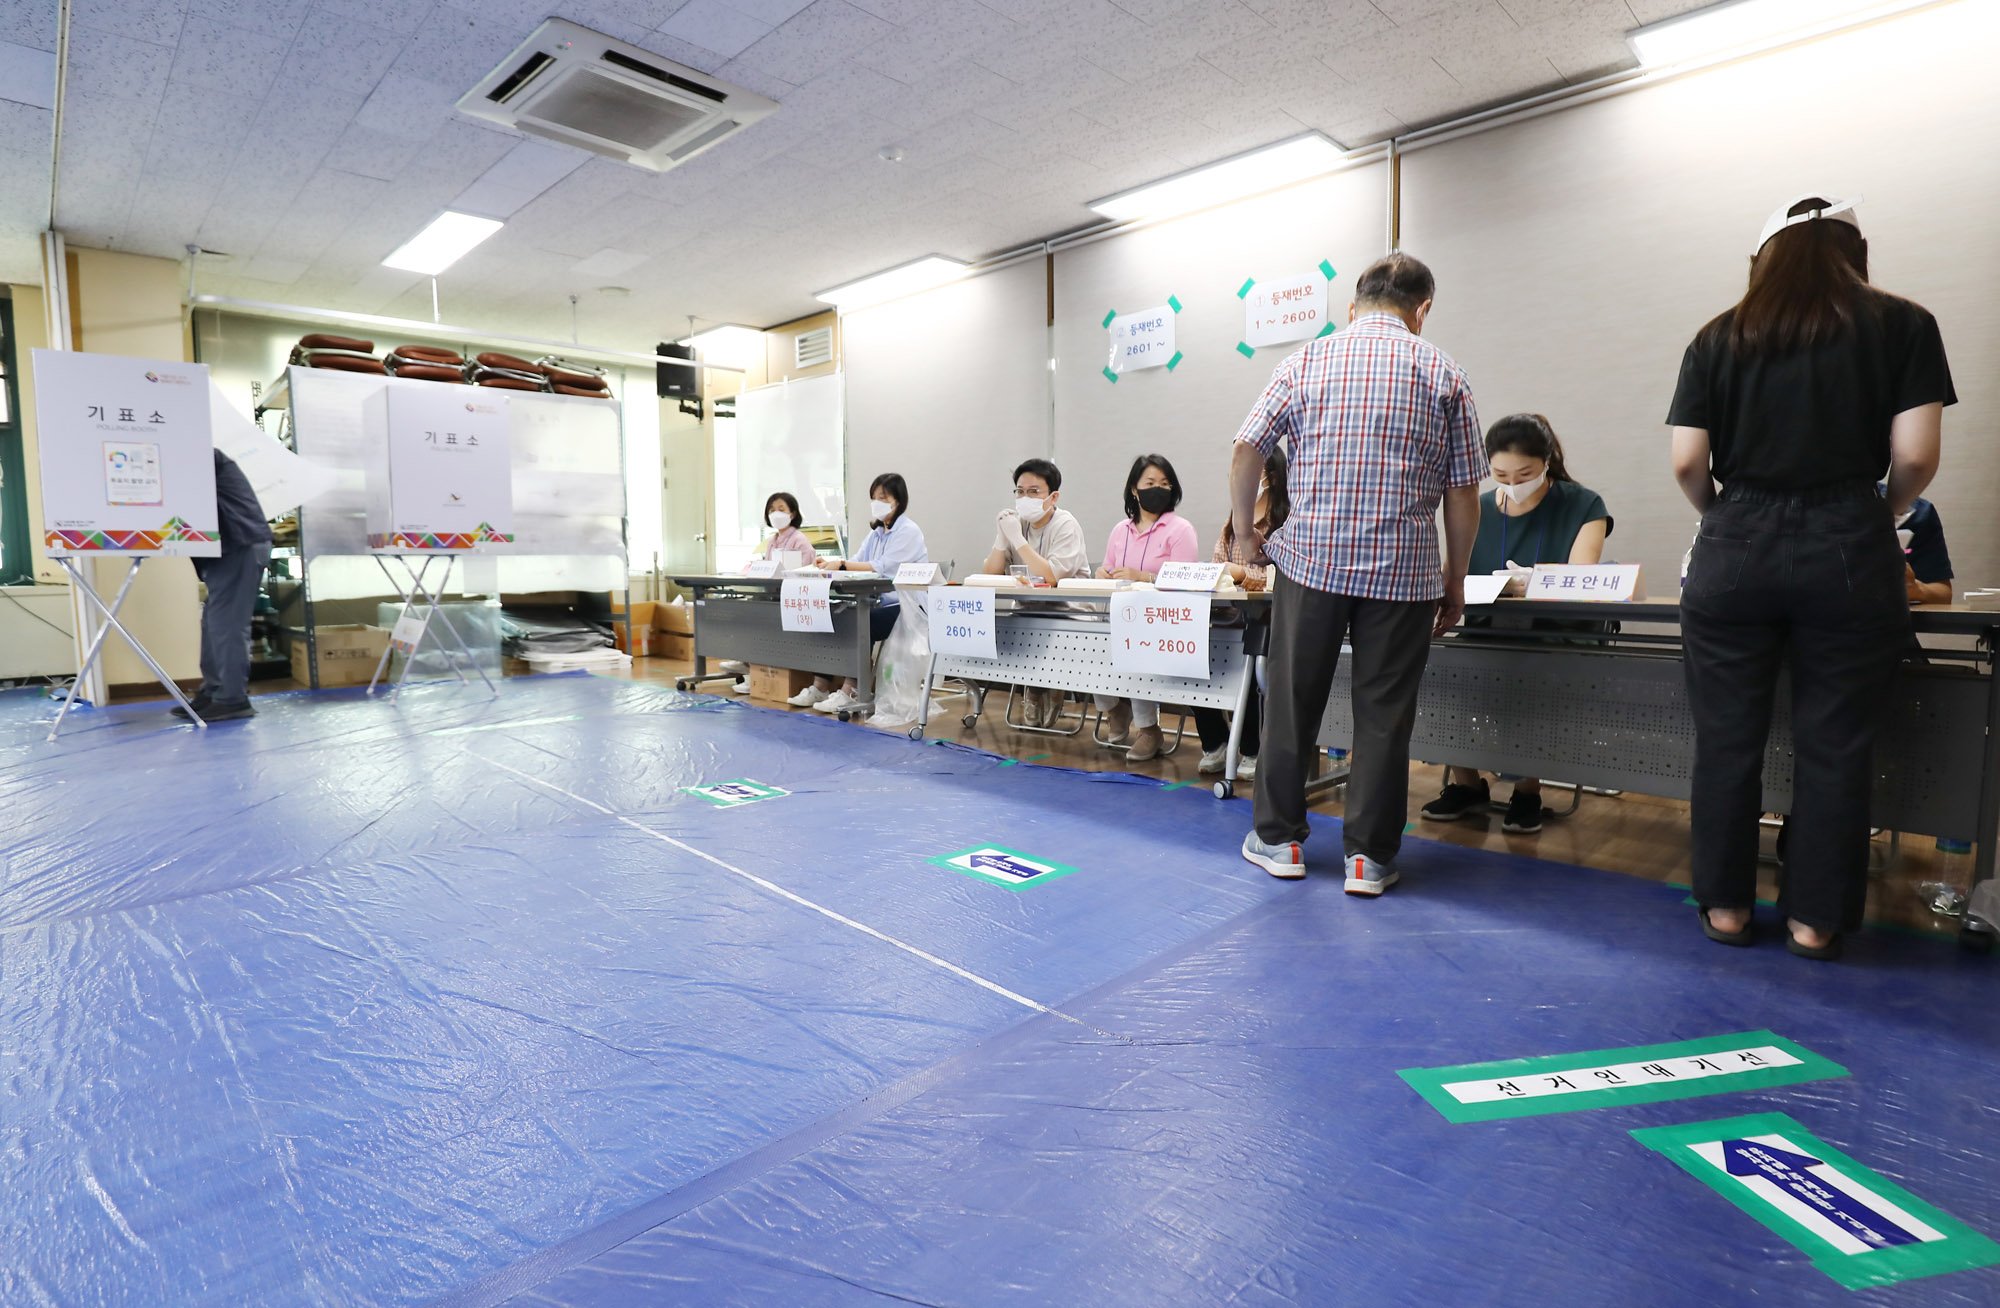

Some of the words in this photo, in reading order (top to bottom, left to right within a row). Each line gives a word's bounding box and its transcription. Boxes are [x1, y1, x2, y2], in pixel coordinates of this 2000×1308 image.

[1271, 285, 1314, 306] 등재번호
[1255, 320, 1260, 329] 1
[1282, 309, 1316, 325] 2600
[1129, 318, 1164, 336] 등재번호
[1127, 343, 1151, 356] 2601
[1161, 570, 1192, 579] 본인확인
[1193, 572, 1208, 581] 하는
[1209, 572, 1218, 580] 곳
[1540, 575, 1621, 590] 투표안내
[784, 599, 811, 610] 투표용지
[812, 600, 828, 609] 배부
[948, 600, 984, 614] 등재번호
[1144, 607, 1193, 625] 등재번호
[946, 625, 972, 638] 2601
[1125, 638, 1130, 650] 1
[1158, 638, 1196, 654] 2600
